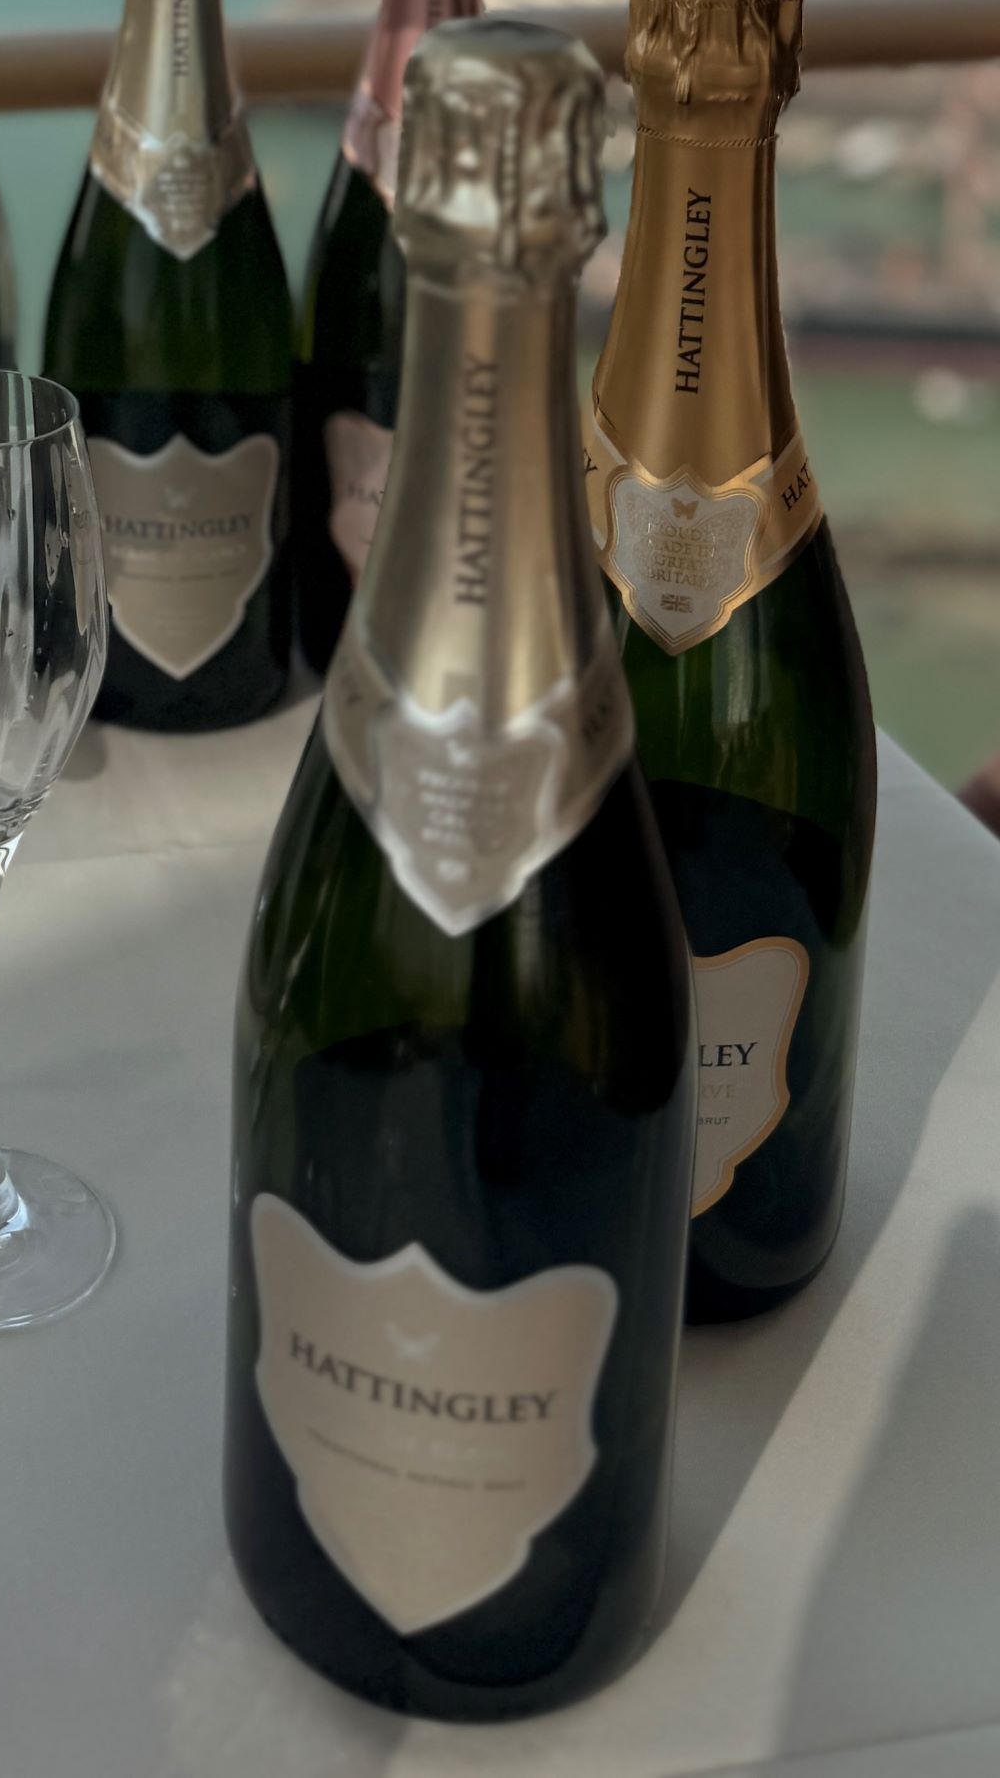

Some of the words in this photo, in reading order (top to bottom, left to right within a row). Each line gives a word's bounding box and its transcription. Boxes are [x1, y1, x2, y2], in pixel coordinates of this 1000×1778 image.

[674, 186, 713, 396] HATTINGLEY
[103, 511, 256, 543] HATTINGLEY
[455, 354, 499, 607] HATTINGLEY
[288, 1328, 561, 1425] HATTINGLEY
